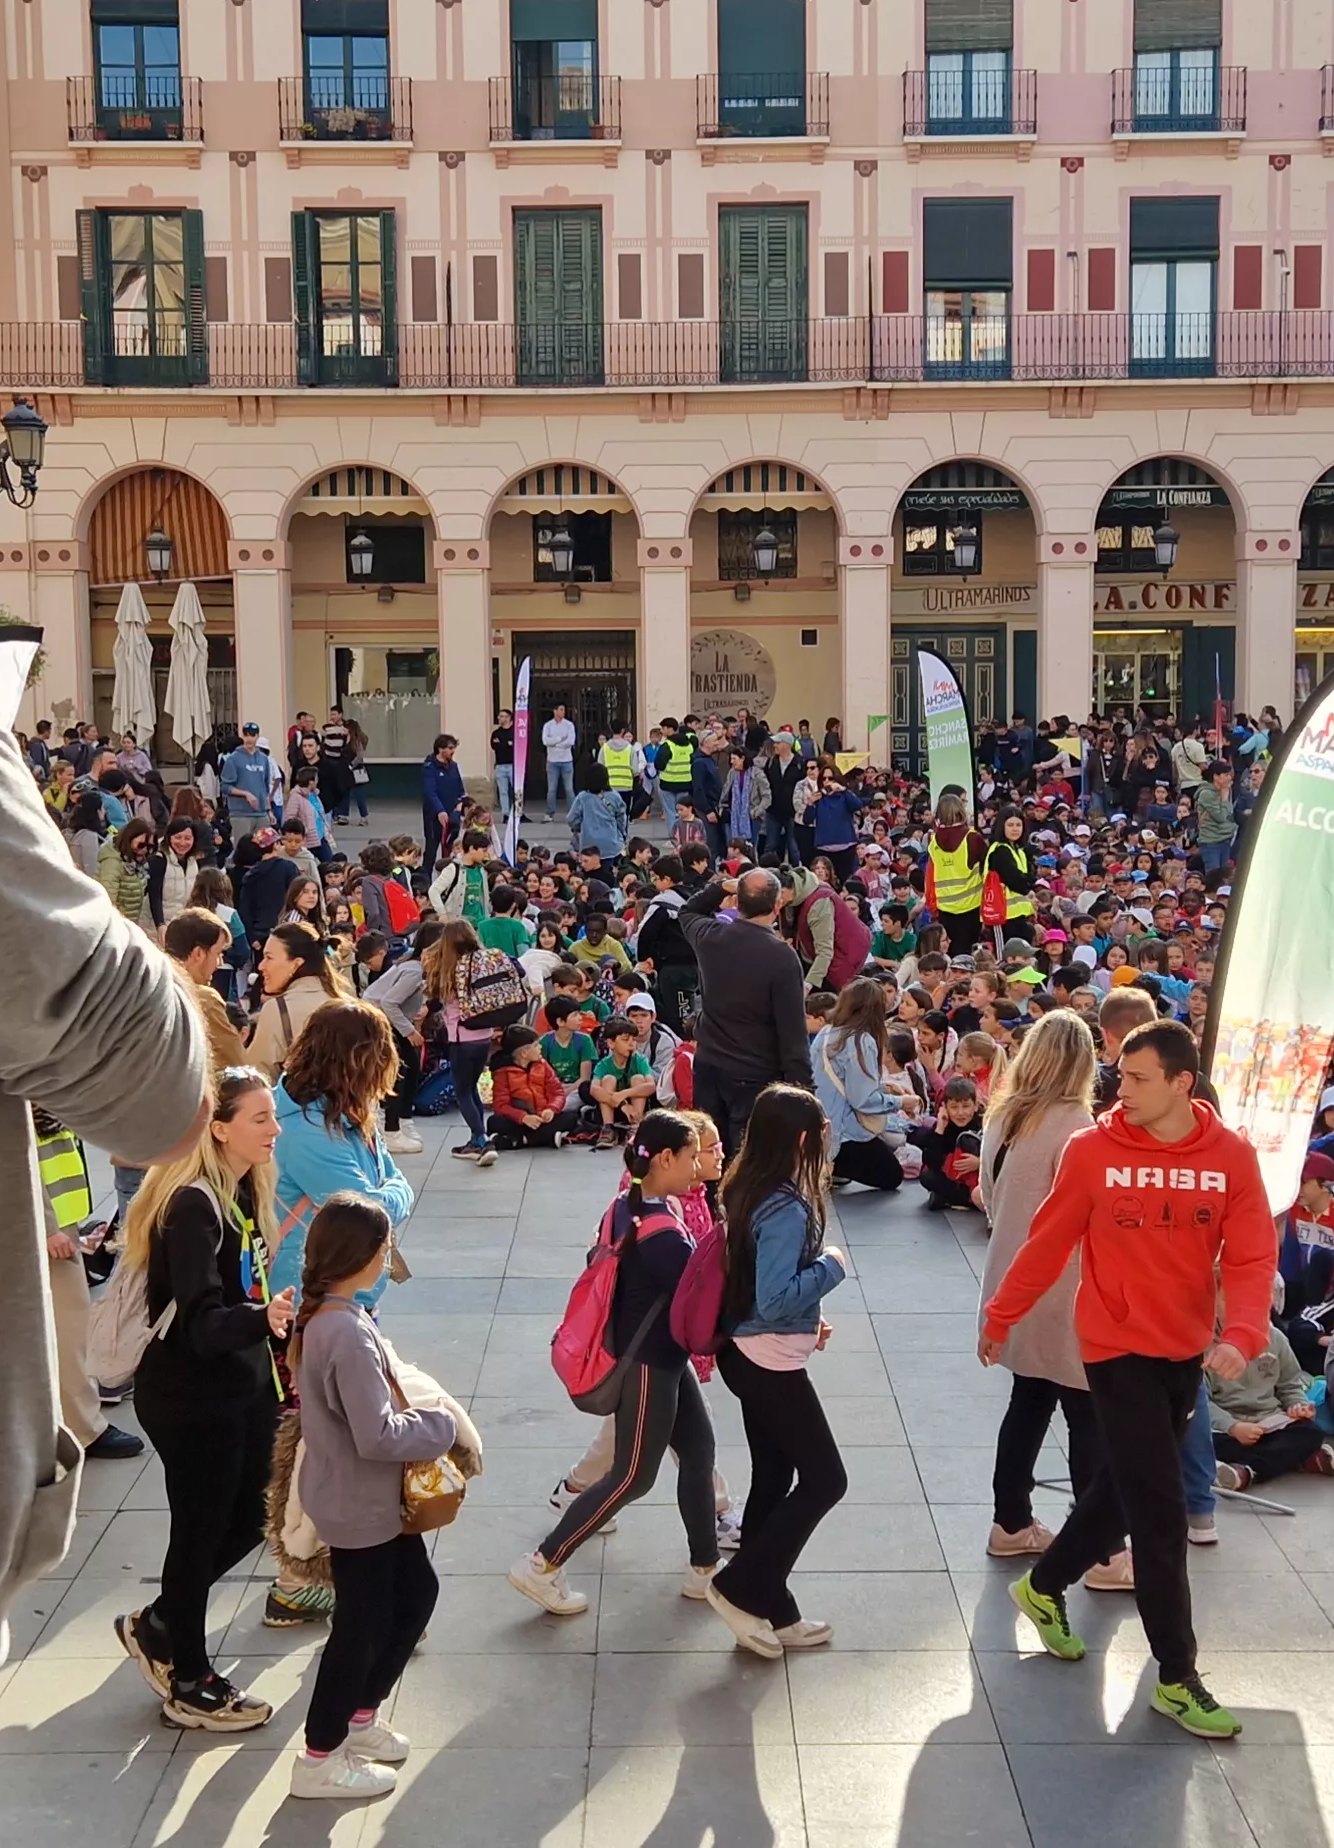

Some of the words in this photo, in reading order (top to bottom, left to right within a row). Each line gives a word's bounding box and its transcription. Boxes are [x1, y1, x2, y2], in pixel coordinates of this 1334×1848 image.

[958, 492, 1020, 508] especialidades
[1156, 489, 1167, 505] LA
[1168, 489, 1212, 505] CONFIANZA
[924, 586, 1031, 612] ULTRAMARINOS
[715, 650, 729, 673] LA
[1105, 1166, 1226, 1193] NASA
